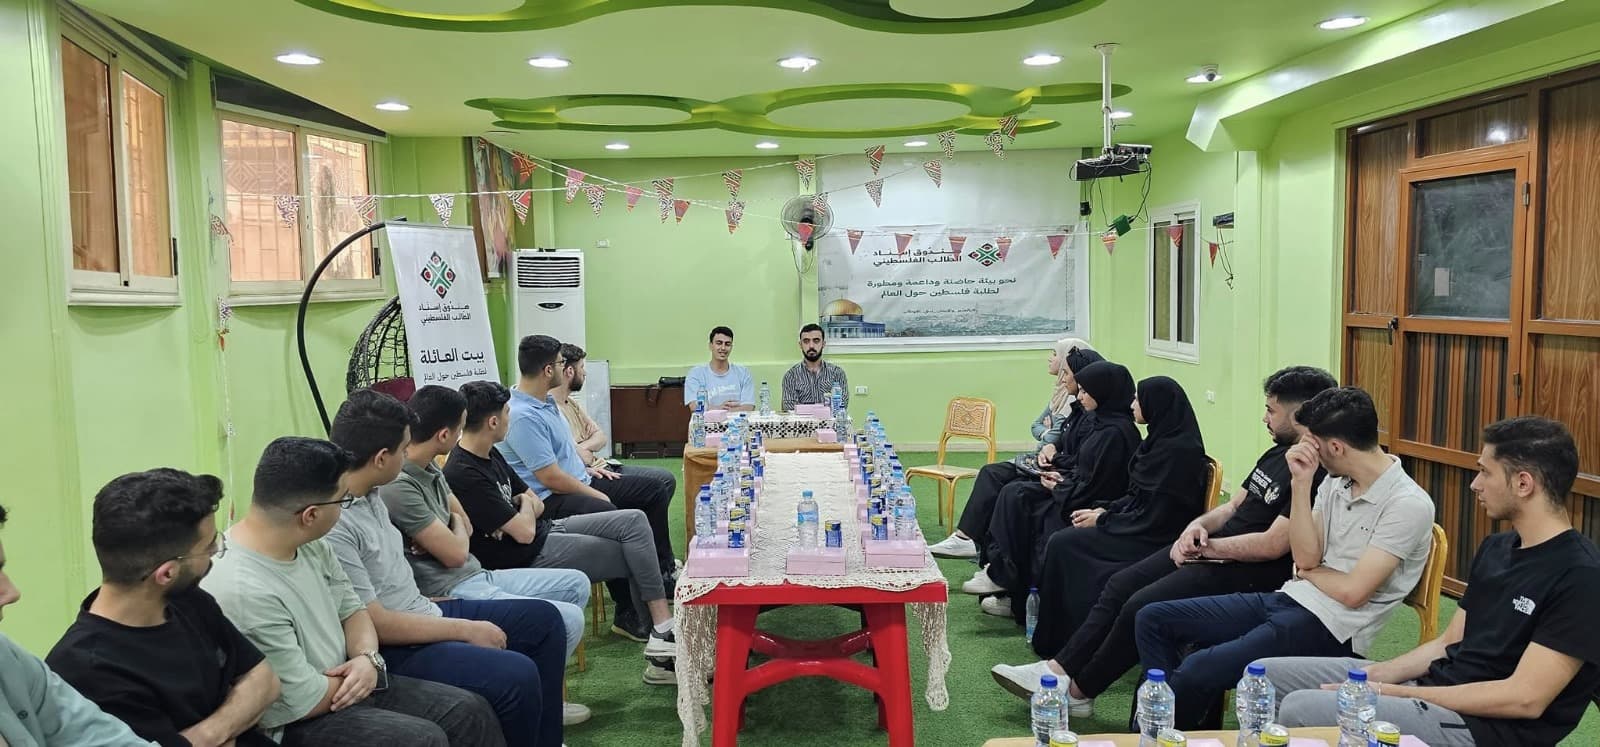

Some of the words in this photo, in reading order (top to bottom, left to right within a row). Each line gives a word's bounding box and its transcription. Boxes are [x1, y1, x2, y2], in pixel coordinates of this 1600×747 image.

[873, 257, 925, 267] الفلسطيني
[867, 280, 903, 288] ومطورة
[998, 277, 1016, 285] نحو
[930, 288, 970, 297] فلسطين
[420, 314, 451, 326] الفلسطيني
[420, 348, 458, 364] العائلة
[462, 351, 484, 363] بيت
[437, 372, 449, 381] حول
[451, 369, 472, 380] فلسطين
